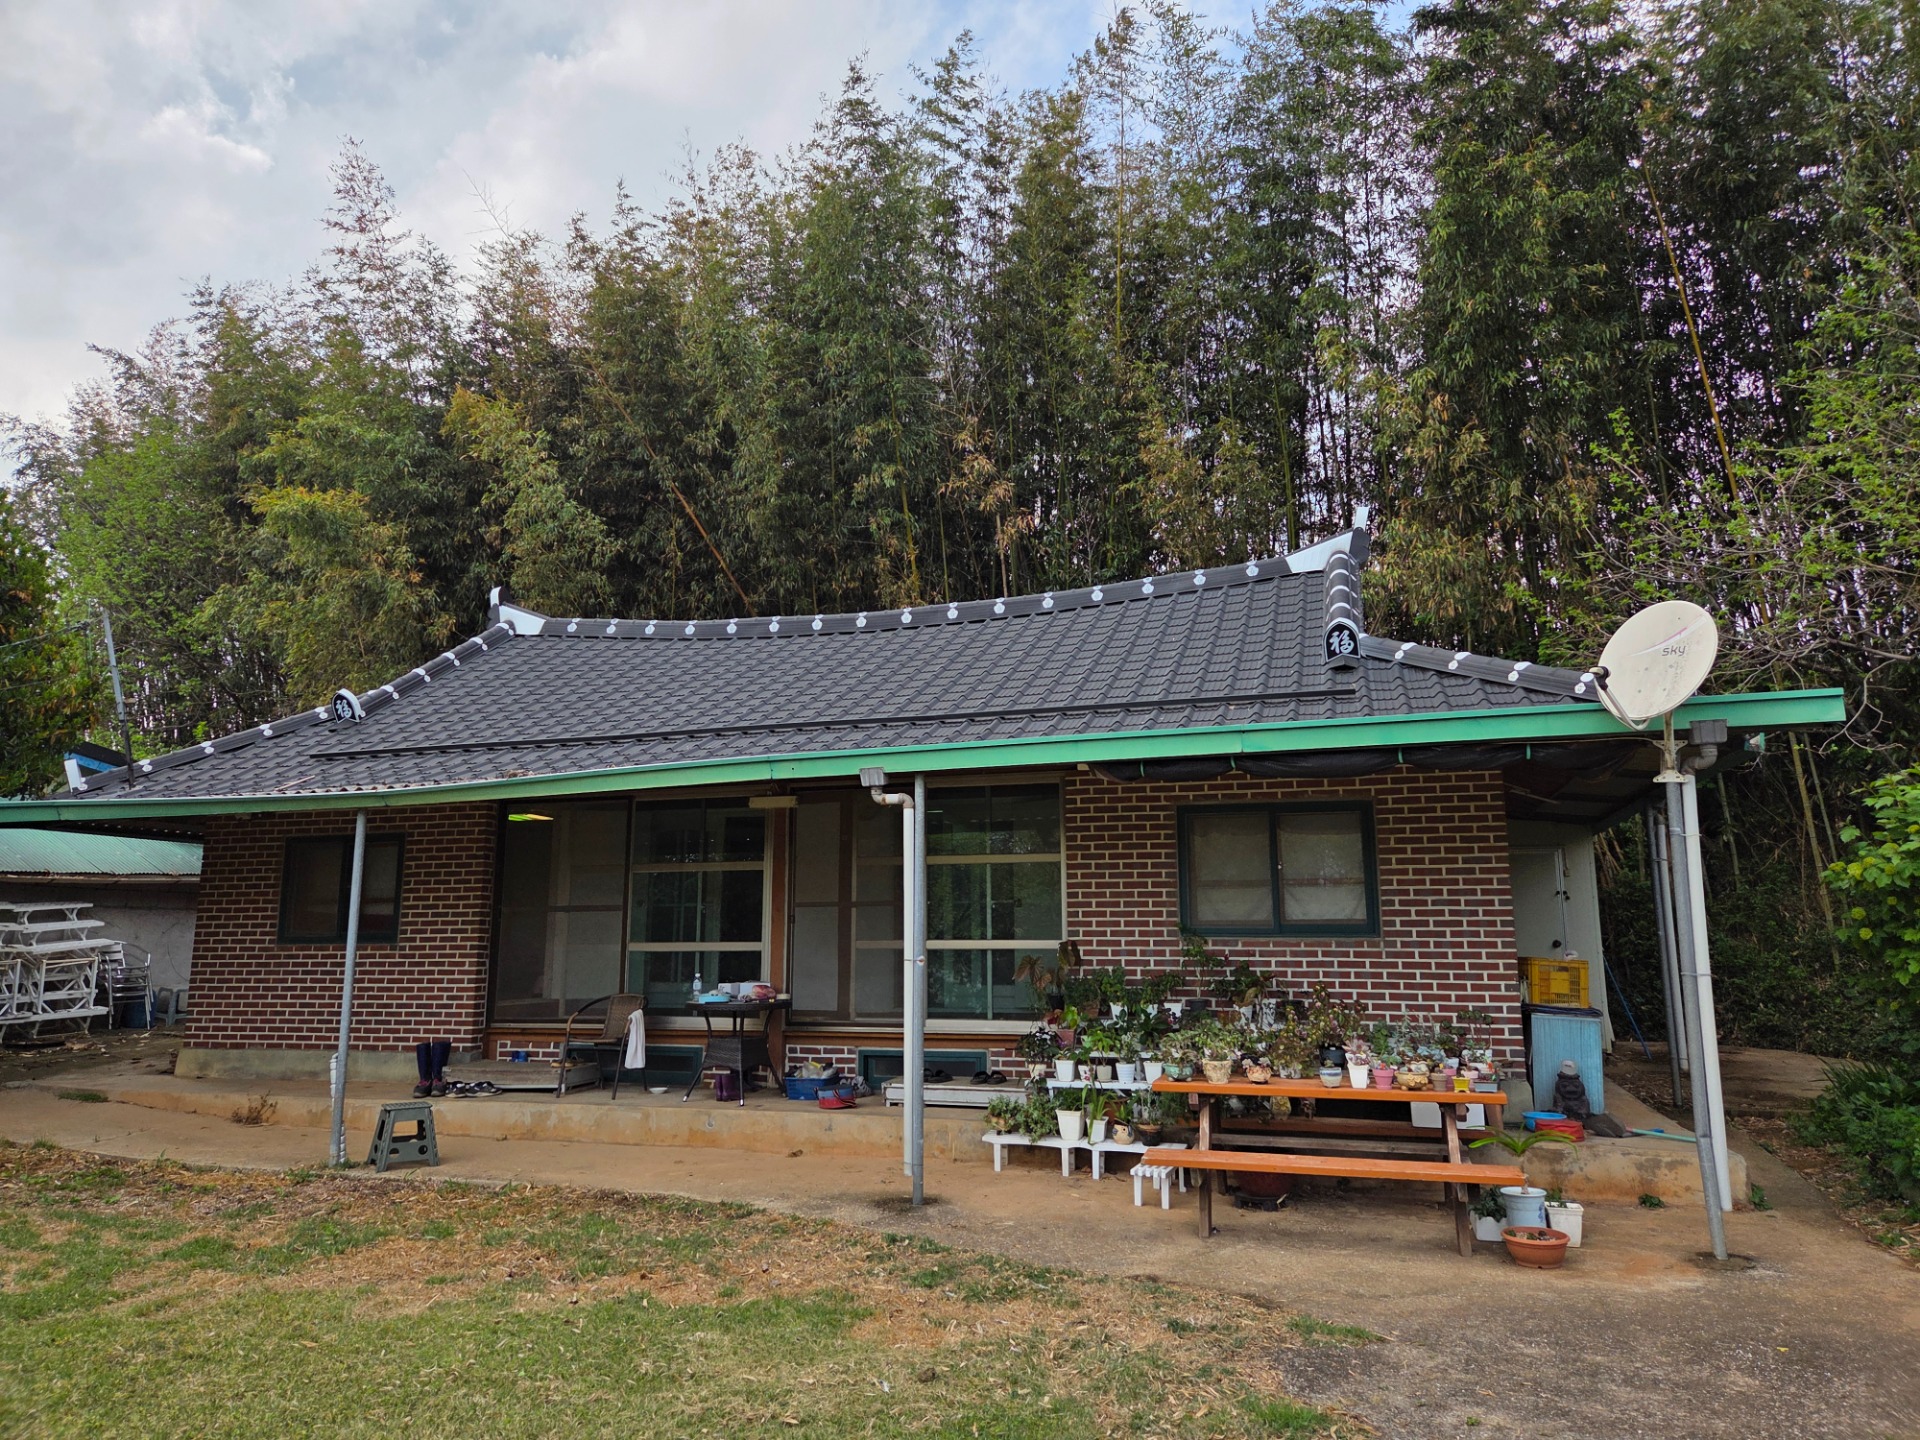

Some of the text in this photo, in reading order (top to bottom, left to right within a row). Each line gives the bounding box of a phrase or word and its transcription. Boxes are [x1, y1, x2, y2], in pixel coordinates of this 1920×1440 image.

[1329, 629, 1355, 654] 福
[1661, 645, 1687, 657] sky
[335, 699, 352, 718] 福
